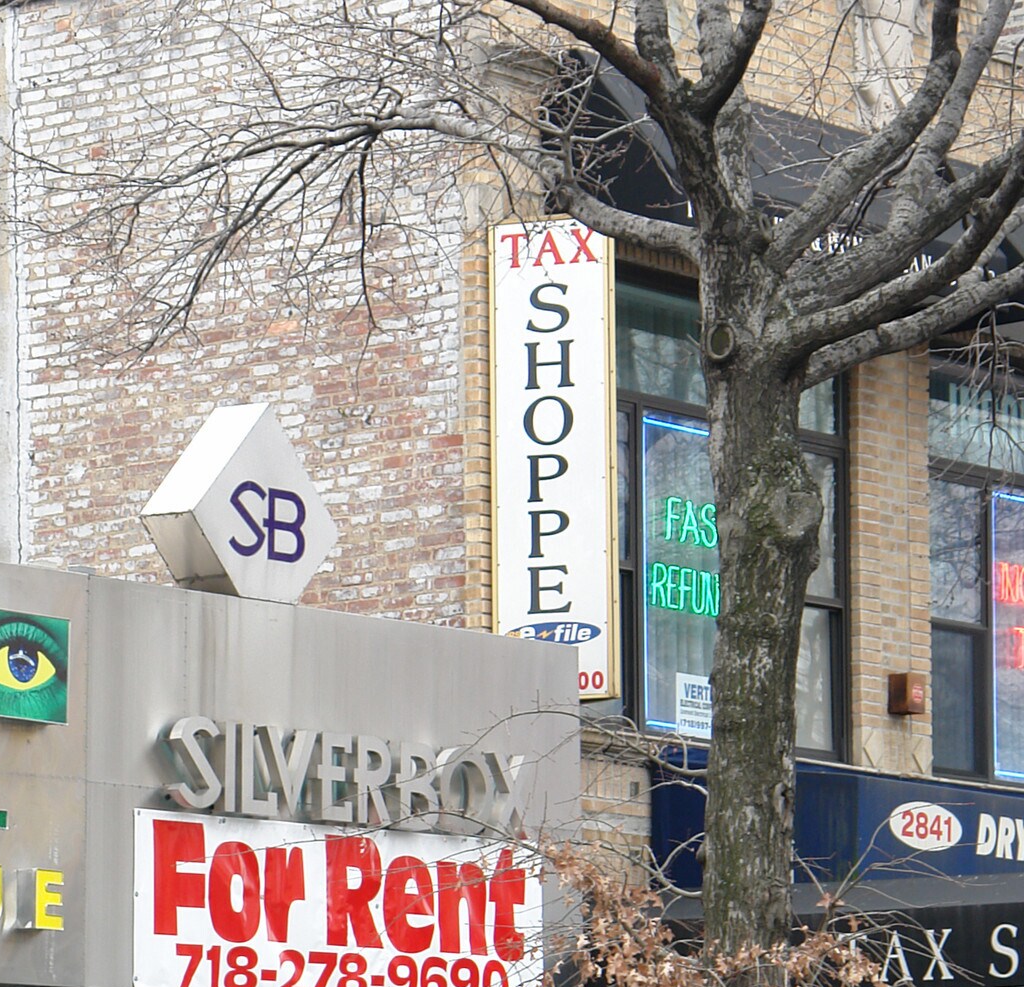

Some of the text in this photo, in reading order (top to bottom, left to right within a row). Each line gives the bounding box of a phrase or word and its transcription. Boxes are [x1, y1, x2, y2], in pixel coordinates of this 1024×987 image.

[500, 226, 598, 269] TAX
[523, 282, 574, 615] SHOPPE
[229, 480, 306, 563] SB
[168, 716, 529, 838] SILVERBOX
[901, 810, 952, 842] 2841
[153, 819, 526, 961] For Rent
